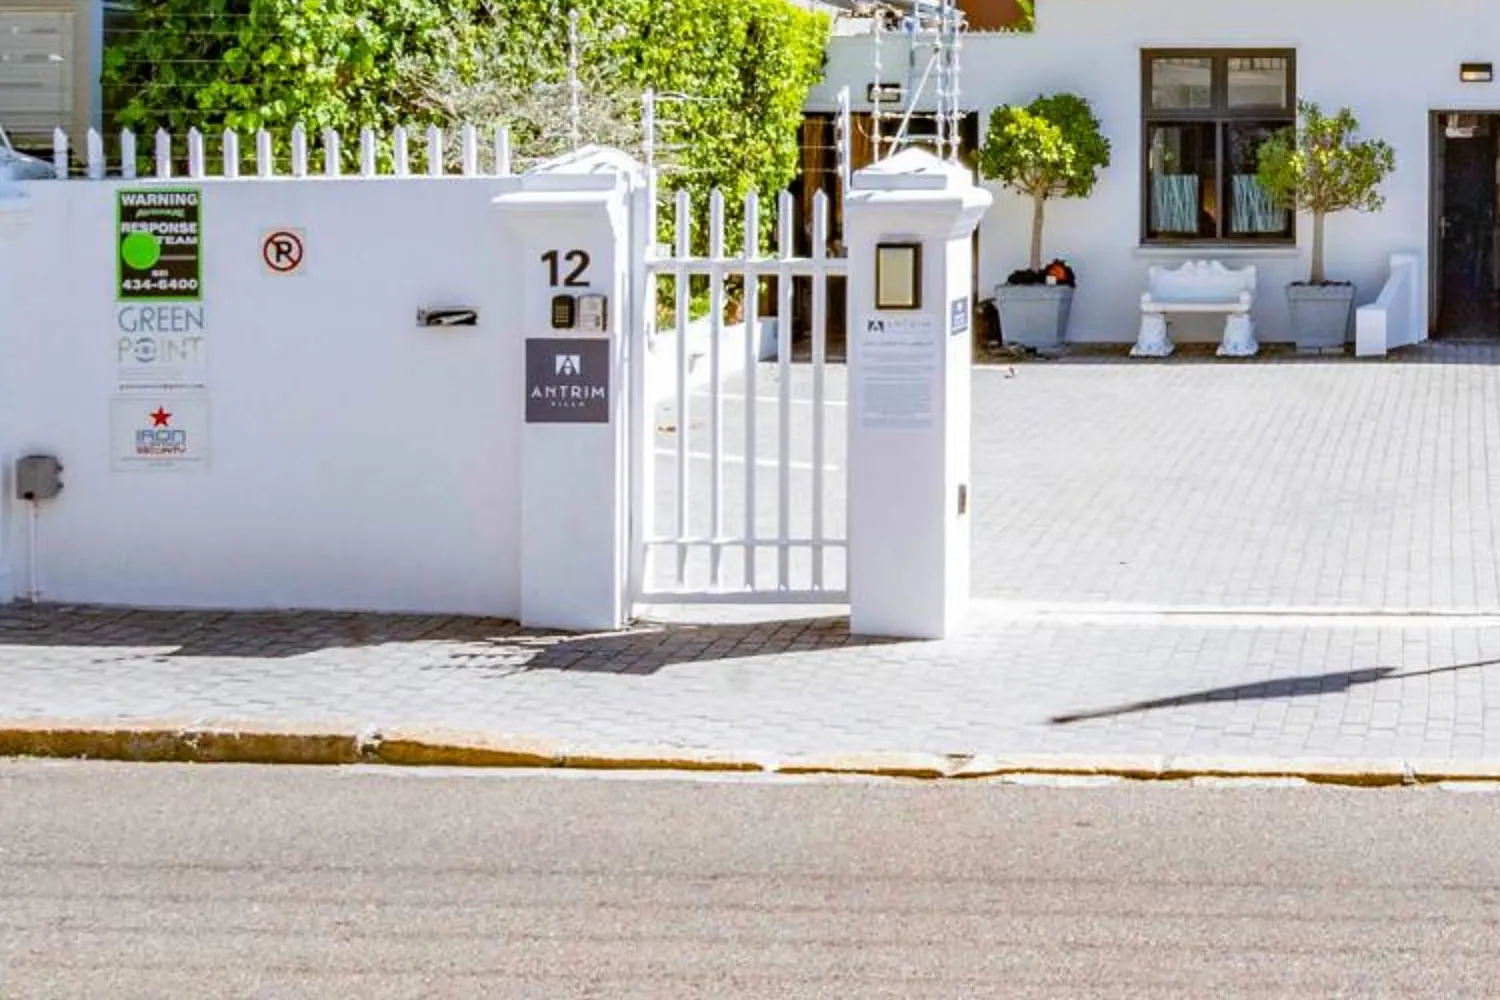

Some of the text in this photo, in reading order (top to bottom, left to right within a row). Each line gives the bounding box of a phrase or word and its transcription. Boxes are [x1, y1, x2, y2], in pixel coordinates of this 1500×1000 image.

[121, 193, 198, 206] WARNING
[121, 222, 197, 233] RESPONSE
[156, 235, 198, 245] TEAM
[541, 250, 590, 286] 12
[122, 279, 198, 290] 434-6400
[118, 306, 204, 332] GREEN
[118, 336, 204, 362] POINT
[531, 386, 605, 398] ANTRIM
[136, 429, 186, 445] IRON
